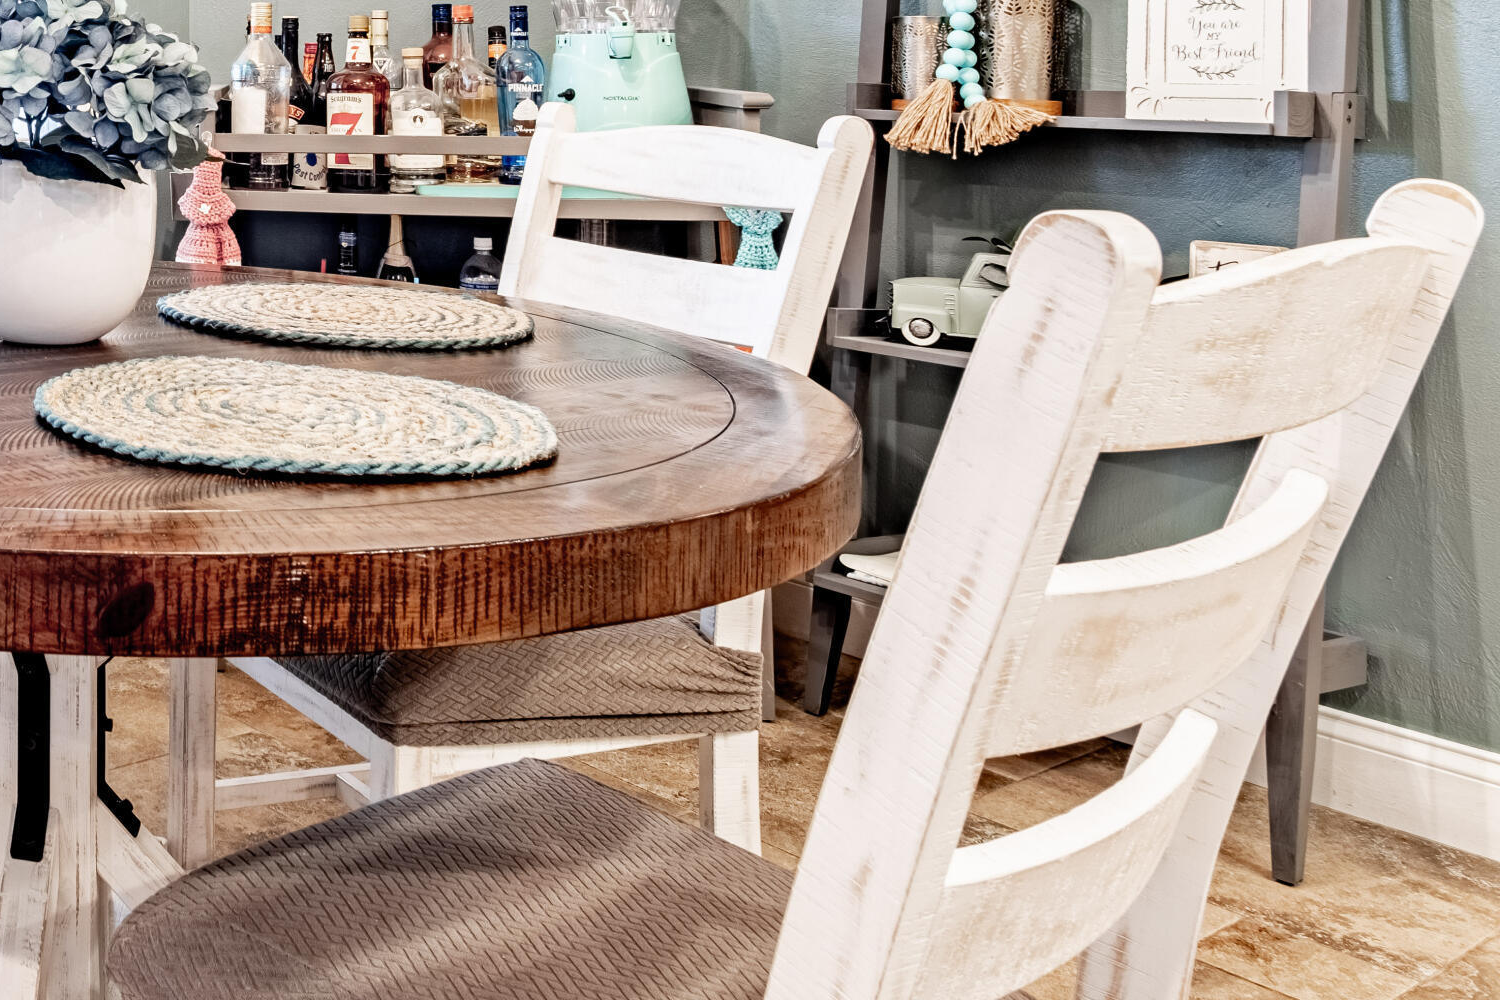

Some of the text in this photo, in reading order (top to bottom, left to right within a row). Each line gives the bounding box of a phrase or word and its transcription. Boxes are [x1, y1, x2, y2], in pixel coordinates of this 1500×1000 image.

[1188, 15, 1241, 38] You are
[350, 45, 360, 60] 7
[1172, 41, 1260, 64] Best Friend
[508, 83, 544, 93] PINNACLE
[330, 111, 363, 165] 7
